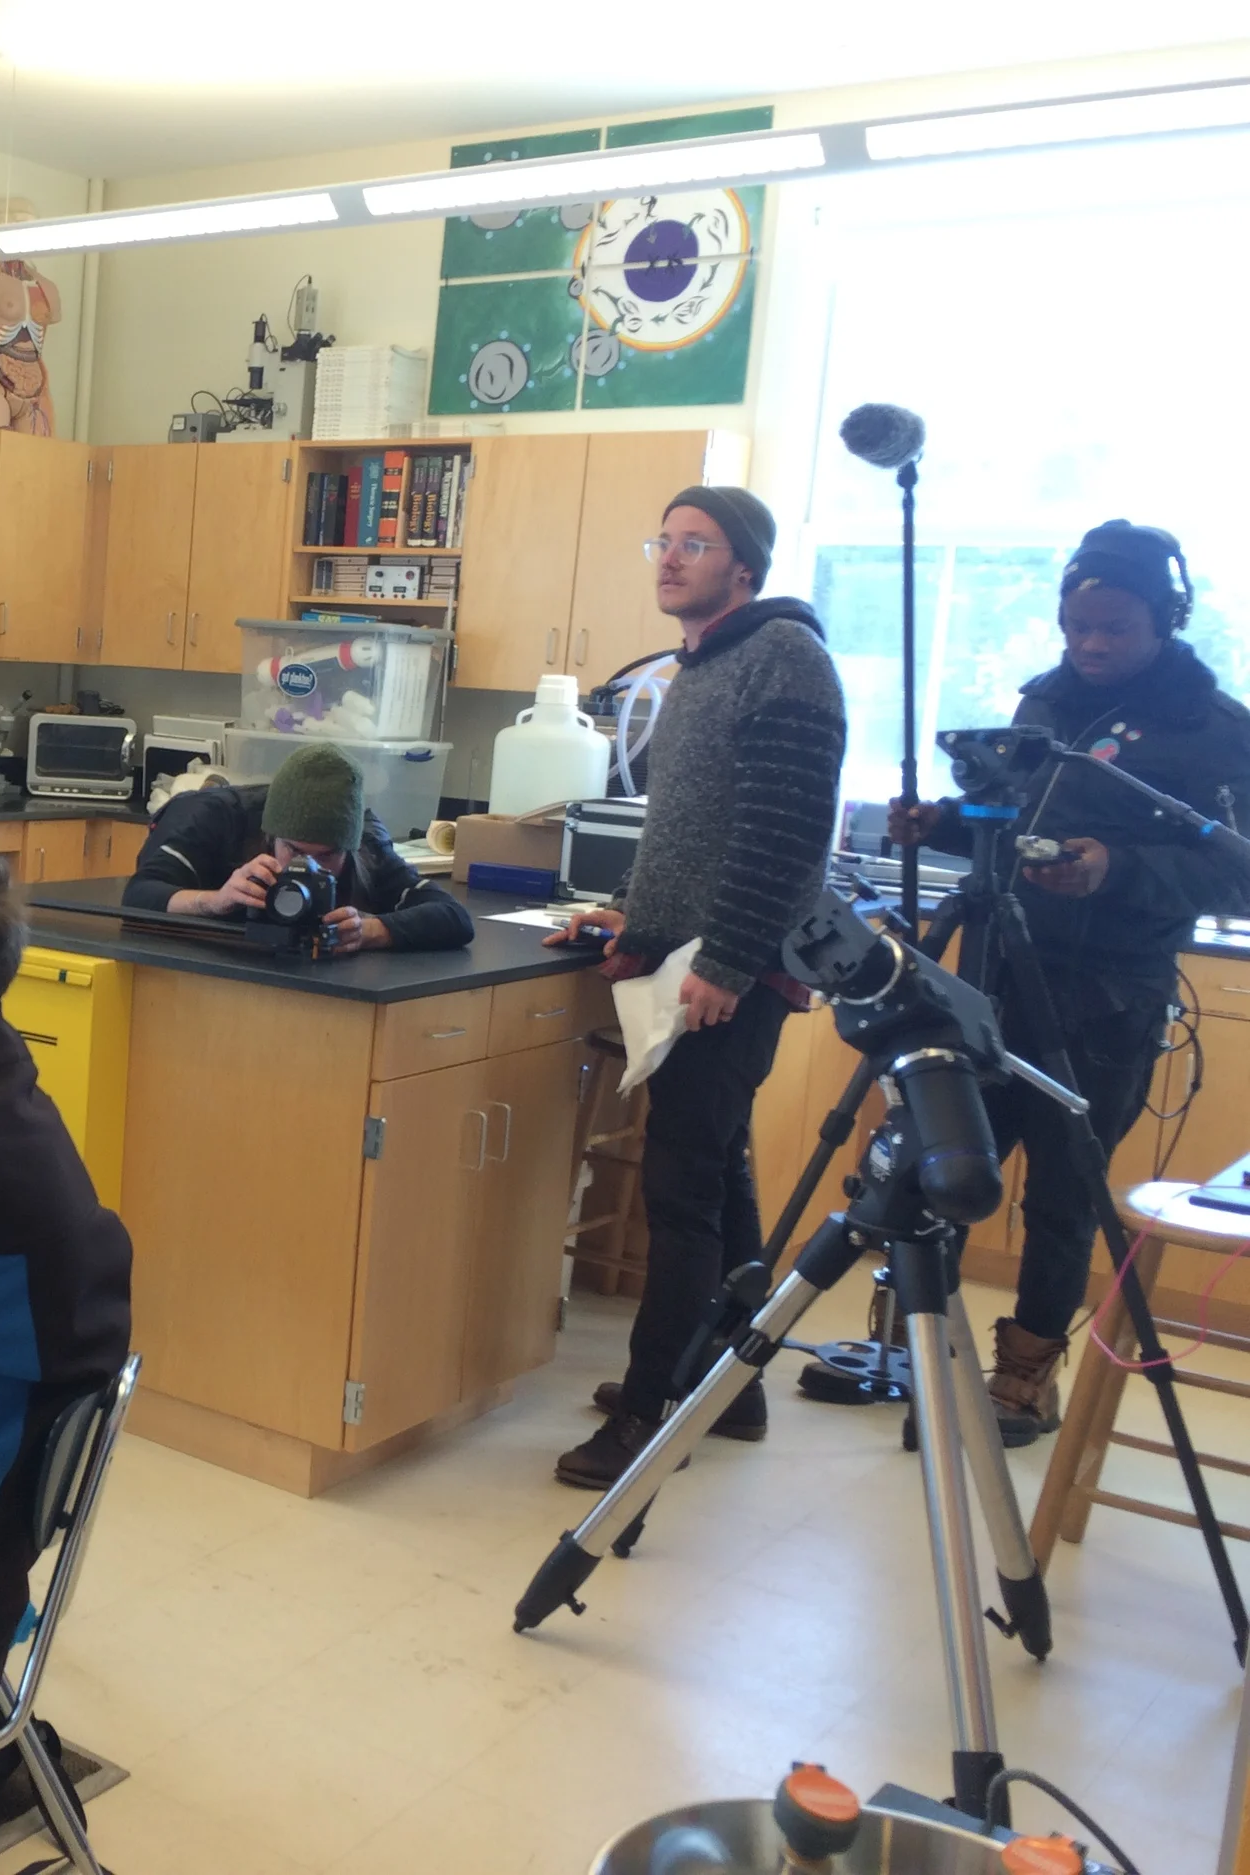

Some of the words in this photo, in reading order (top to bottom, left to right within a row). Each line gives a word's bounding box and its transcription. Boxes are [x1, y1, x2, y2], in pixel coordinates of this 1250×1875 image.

[365, 506, 376, 528] Surgery
[409, 493, 423, 534] Biology
[423, 493, 437, 534] Biology
[282, 671, 290, 685] got
